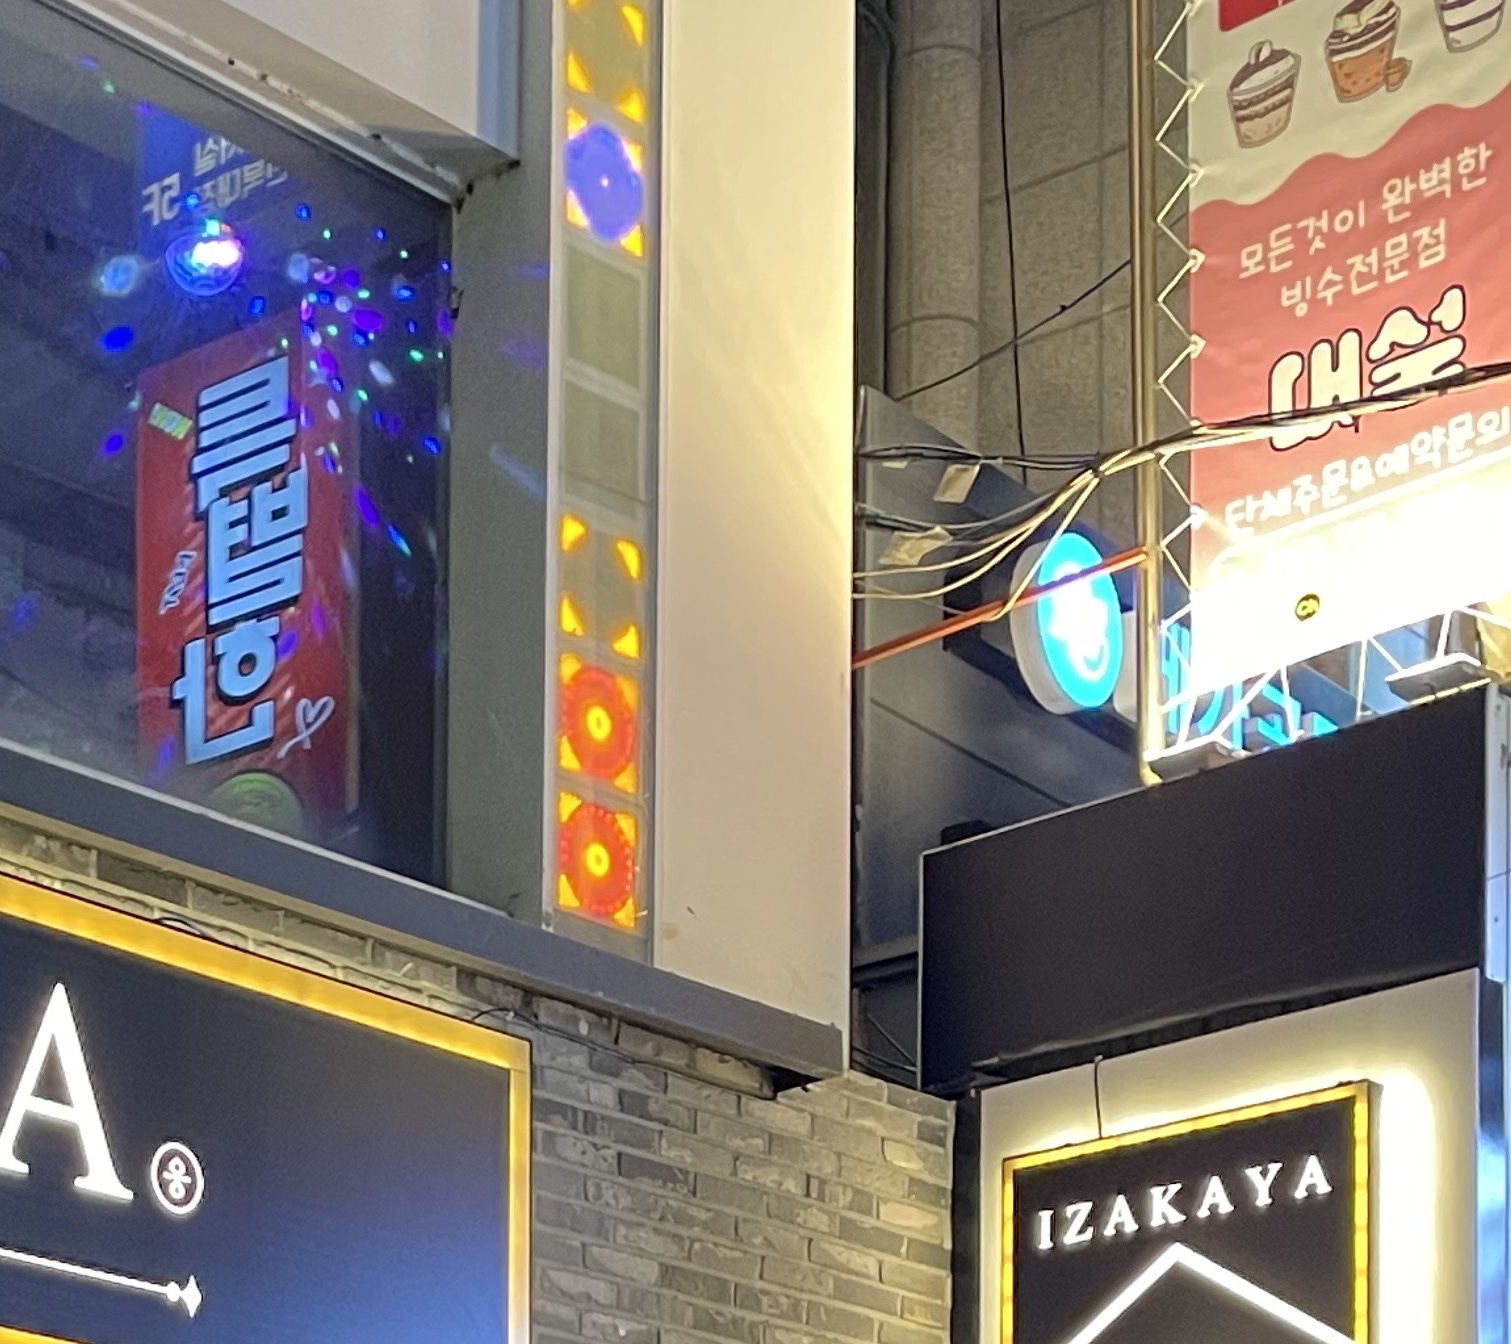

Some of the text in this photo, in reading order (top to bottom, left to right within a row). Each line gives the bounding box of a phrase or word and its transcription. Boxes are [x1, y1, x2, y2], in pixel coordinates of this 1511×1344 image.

[1238, 141, 1493, 280] 모든것이 완벽한
[1280, 218, 1447, 318] 빙수전문점
[1036, 1153, 1333, 1250] IZAKAYA
